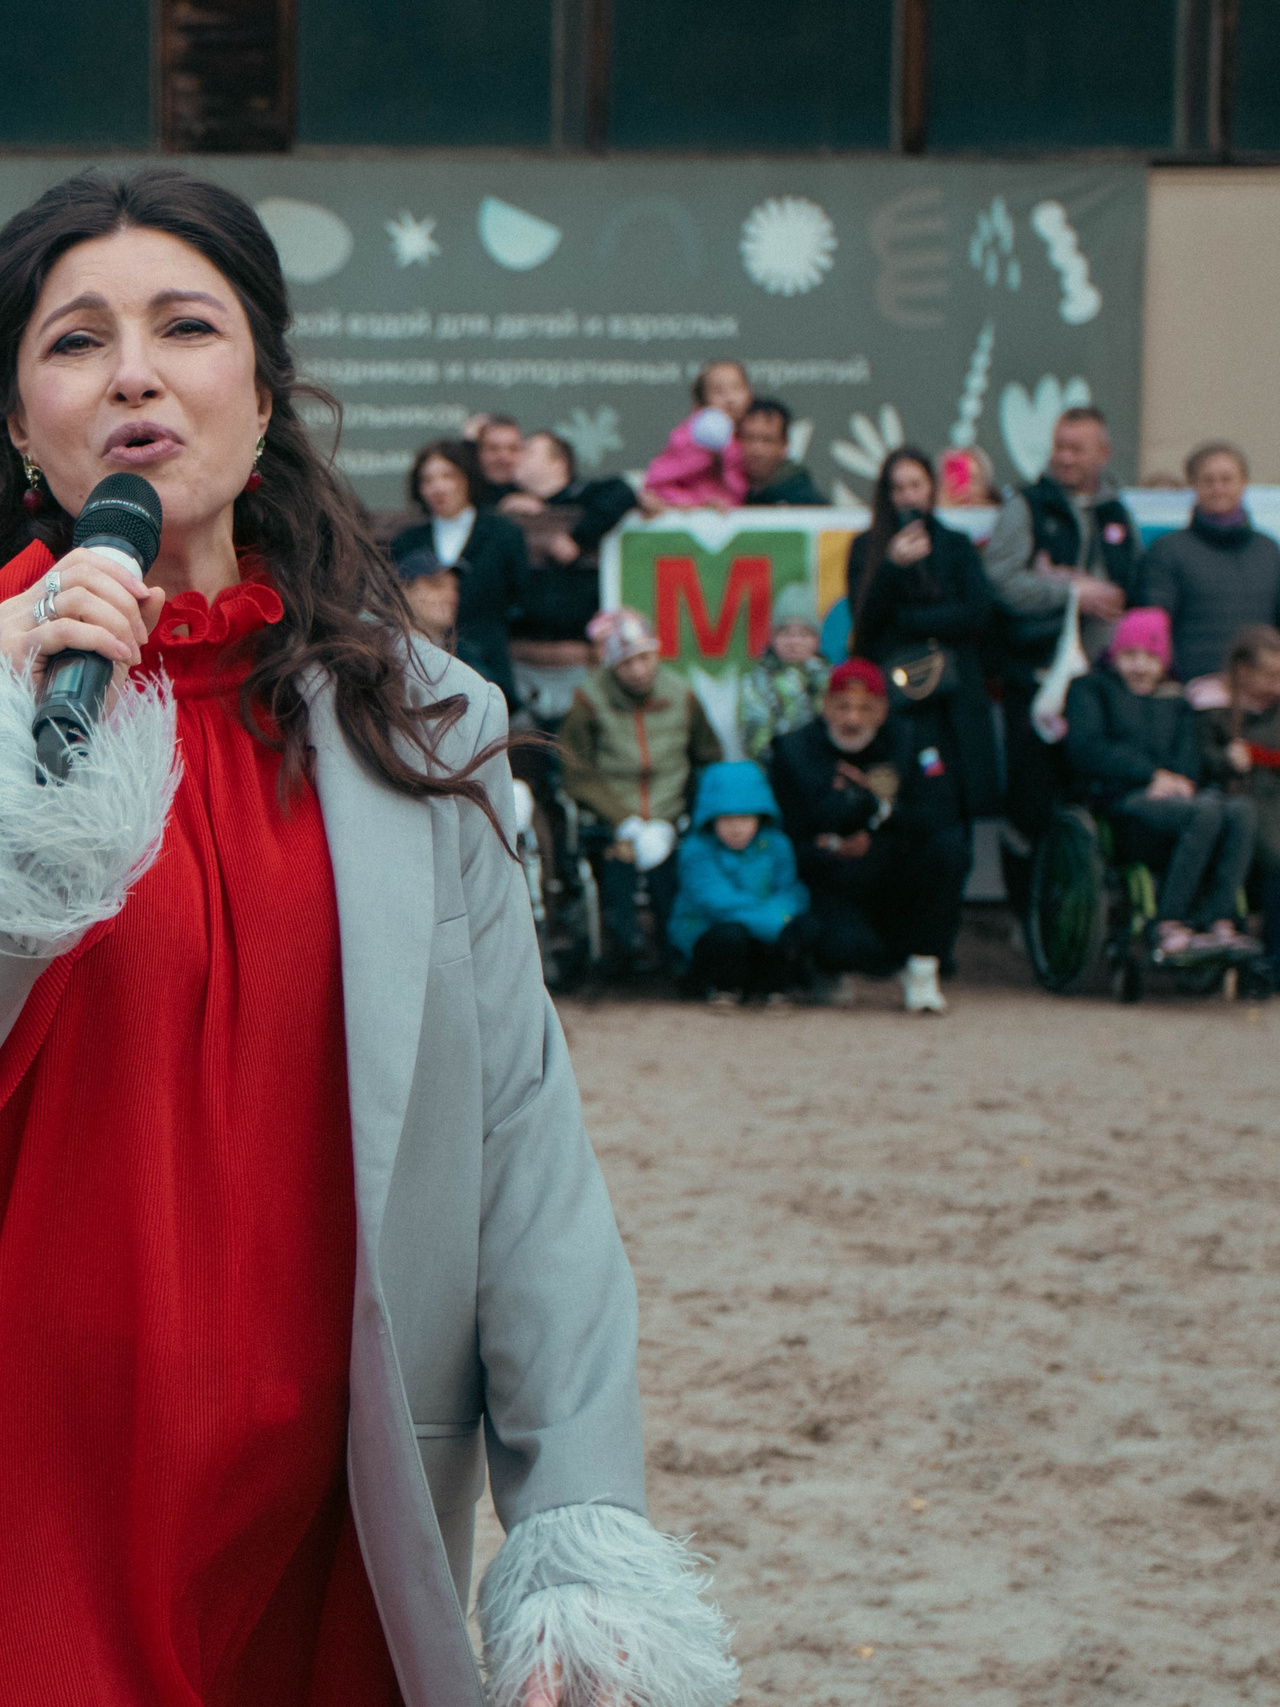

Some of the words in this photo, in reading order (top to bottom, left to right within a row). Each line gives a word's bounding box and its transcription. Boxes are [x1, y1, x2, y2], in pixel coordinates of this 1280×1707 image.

[435, 312, 490, 342] для
[492, 308, 577, 340] детей
[582, 314, 603, 337] и
[606, 313, 739, 344] взрослых
[442, 359, 465, 383] и
[100, 499, 151, 518] SENNHEISER
